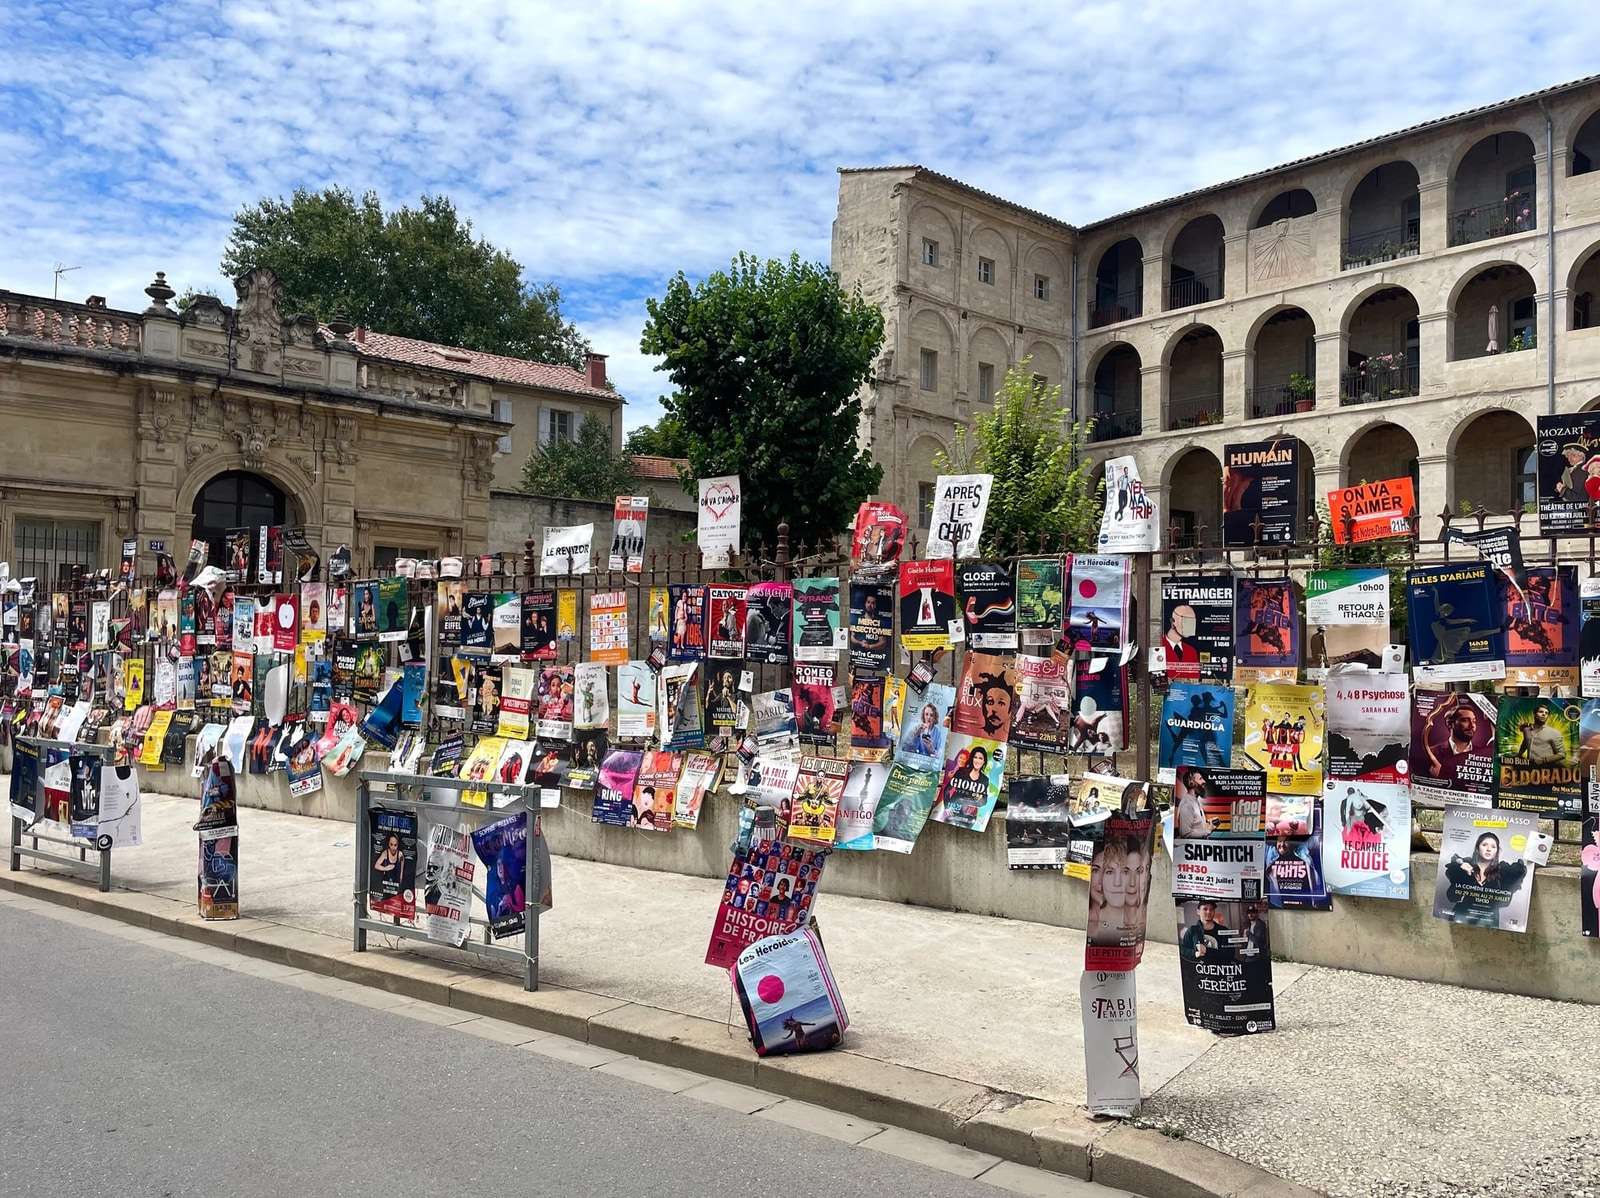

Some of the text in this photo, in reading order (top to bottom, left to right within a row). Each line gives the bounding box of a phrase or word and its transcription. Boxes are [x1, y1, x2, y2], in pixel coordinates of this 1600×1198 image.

[1539, 427, 1586, 437] MOZART
[944, 484, 982, 508] APRES
[1343, 483, 1390, 503] ON VA
[950, 502, 964, 522] LE
[1340, 496, 1403, 517] S'AIMER
[938, 521, 972, 541] CHAOS
[546, 547, 556, 557] LE
[1074, 557, 1119, 567] Les Héroïdes
[963, 572, 996, 582] CLOSET
[1410, 569, 1486, 586] FILLES D'ARIANE
[1162, 585, 1233, 600] L'ÉTRANGER
[1358, 583, 1385, 592] 10h00
[1338, 601, 1385, 612] RETOUR À
[1342, 610, 1385, 620] ITHAQUE
[796, 667, 834, 678] ROMEO
[796, 676, 833, 687] JULIETTE
[964, 676, 974, 687] FA
[1336, 689, 1406, 700] 4.48 Psychose
[959, 696, 982, 707] AUX
[1167, 718, 1225, 733] GUARDIOLA
[1205, 715, 1222, 725] LOS
[1039, 733, 1057, 742] 22h15
[1468, 753, 1493, 762] Pierre
[803, 758, 814, 770] LES
[761, 766, 788, 779] LA FOLIE
[1456, 765, 1482, 775] FACE
[602, 789, 623, 802] RING
[1442, 790, 1469, 798] D'ENCRE
[1498, 800, 1521, 810] 14H30
[1452, 810, 1488, 821] VICTORIA
[1490, 815, 1531, 826] PIANASSO
[1344, 841, 1386, 852] LE CARNET
[1184, 843, 1254, 863] SAPRITCH
[1341, 852, 1389, 871] ROUGE
[1177, 863, 1208, 874] 11H30
[1270, 864, 1307, 879] 14H15
[1215, 876, 1234, 885] juillet
[1462, 884, 1484, 892] COMÉDIE
[1484, 887, 1512, 896] D'AVIGNON
[722, 922, 739, 936] DE
[739, 937, 799, 965] Les Héroïdes
[1196, 963, 1243, 976] QUENTIN
[1198, 978, 1248, 993] JÉRÉMIE
